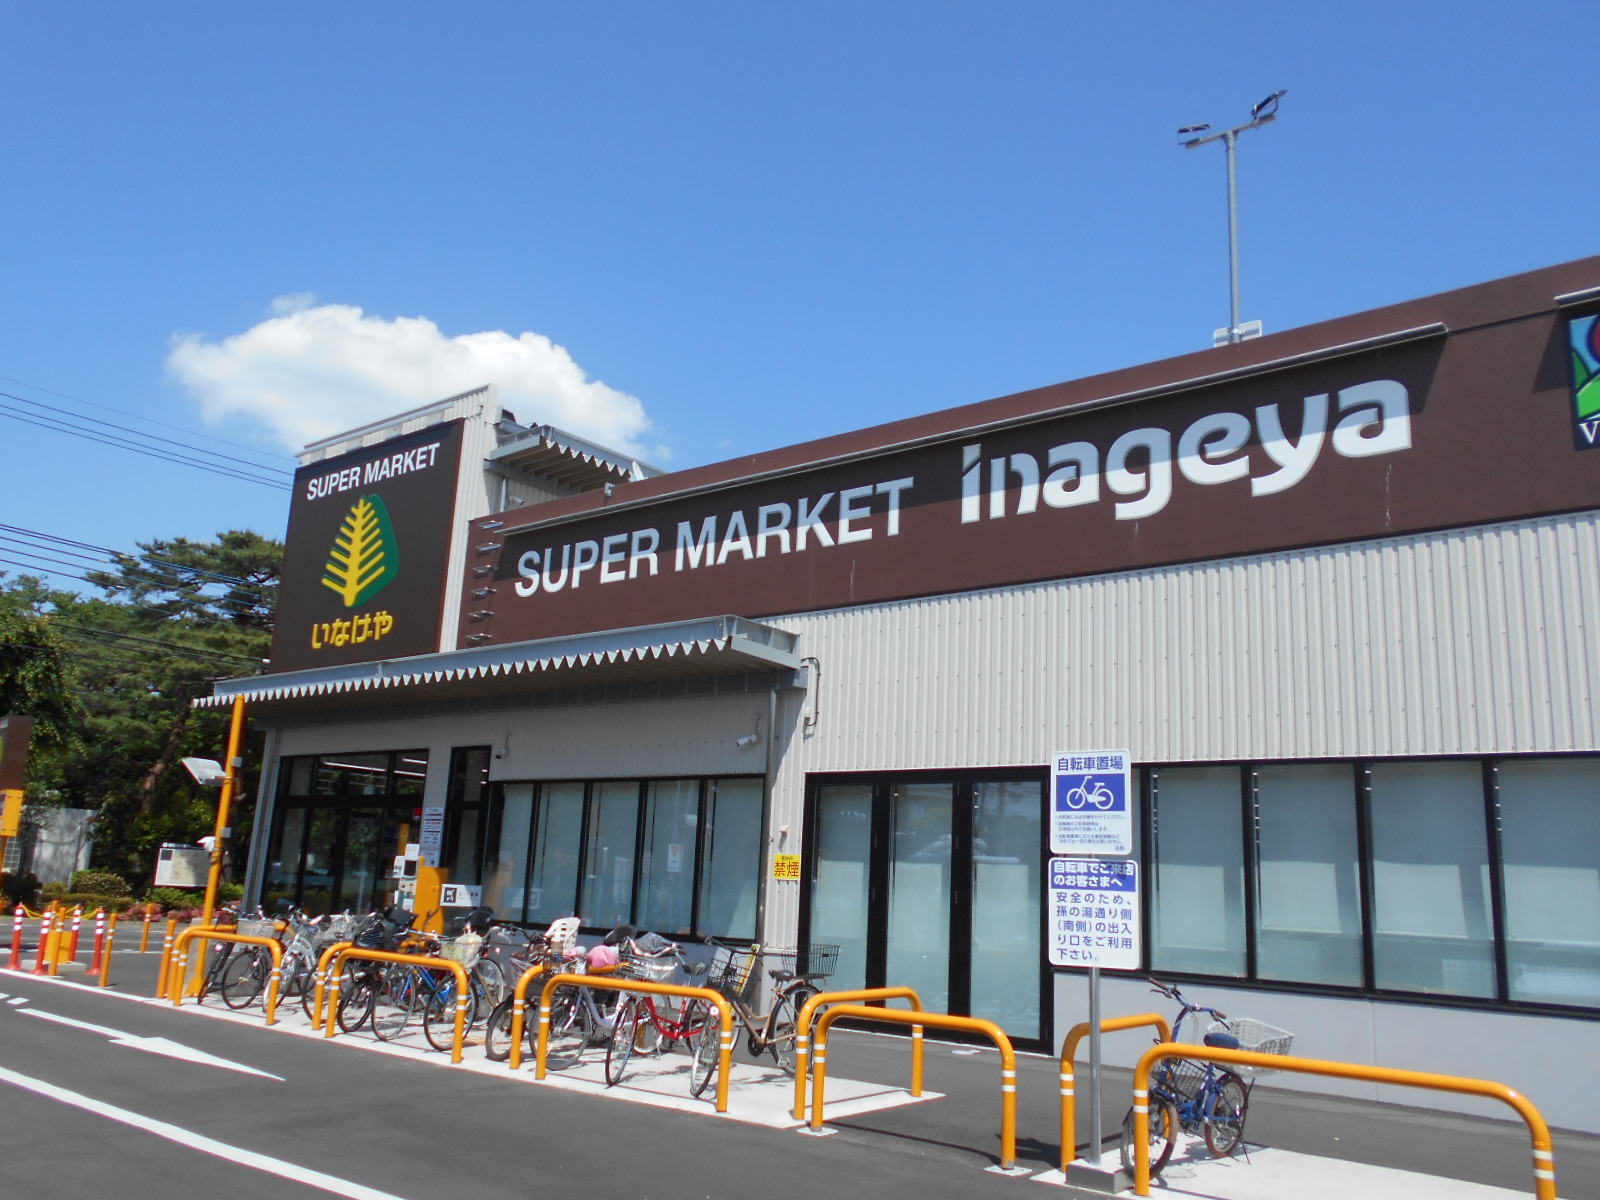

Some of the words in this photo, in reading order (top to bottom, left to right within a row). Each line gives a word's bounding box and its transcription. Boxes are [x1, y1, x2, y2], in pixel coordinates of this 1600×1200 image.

[961, 380, 1412, 521] inageya
[306, 467, 361, 500] SUPER
[363, 442, 440, 484] MARKET
[514, 527, 659, 598] SUPER
[674, 476, 915, 572] MARKET
[311, 610, 394, 650] いなげや
[1057, 755, 1124, 771] 自転車置場
[774, 861, 800, 877] 禁煙
[1054, 861, 1135, 876] 自転車でご来店
[1053, 874, 1123, 888] のお客さまへ
[1056, 891, 1132, 906] 安全のため、
[1056, 905, 1132, 921] 孫の湯通り側
[1058, 933, 1132, 949] り口をご利用
[1056, 947, 1100, 962] 下さい。
